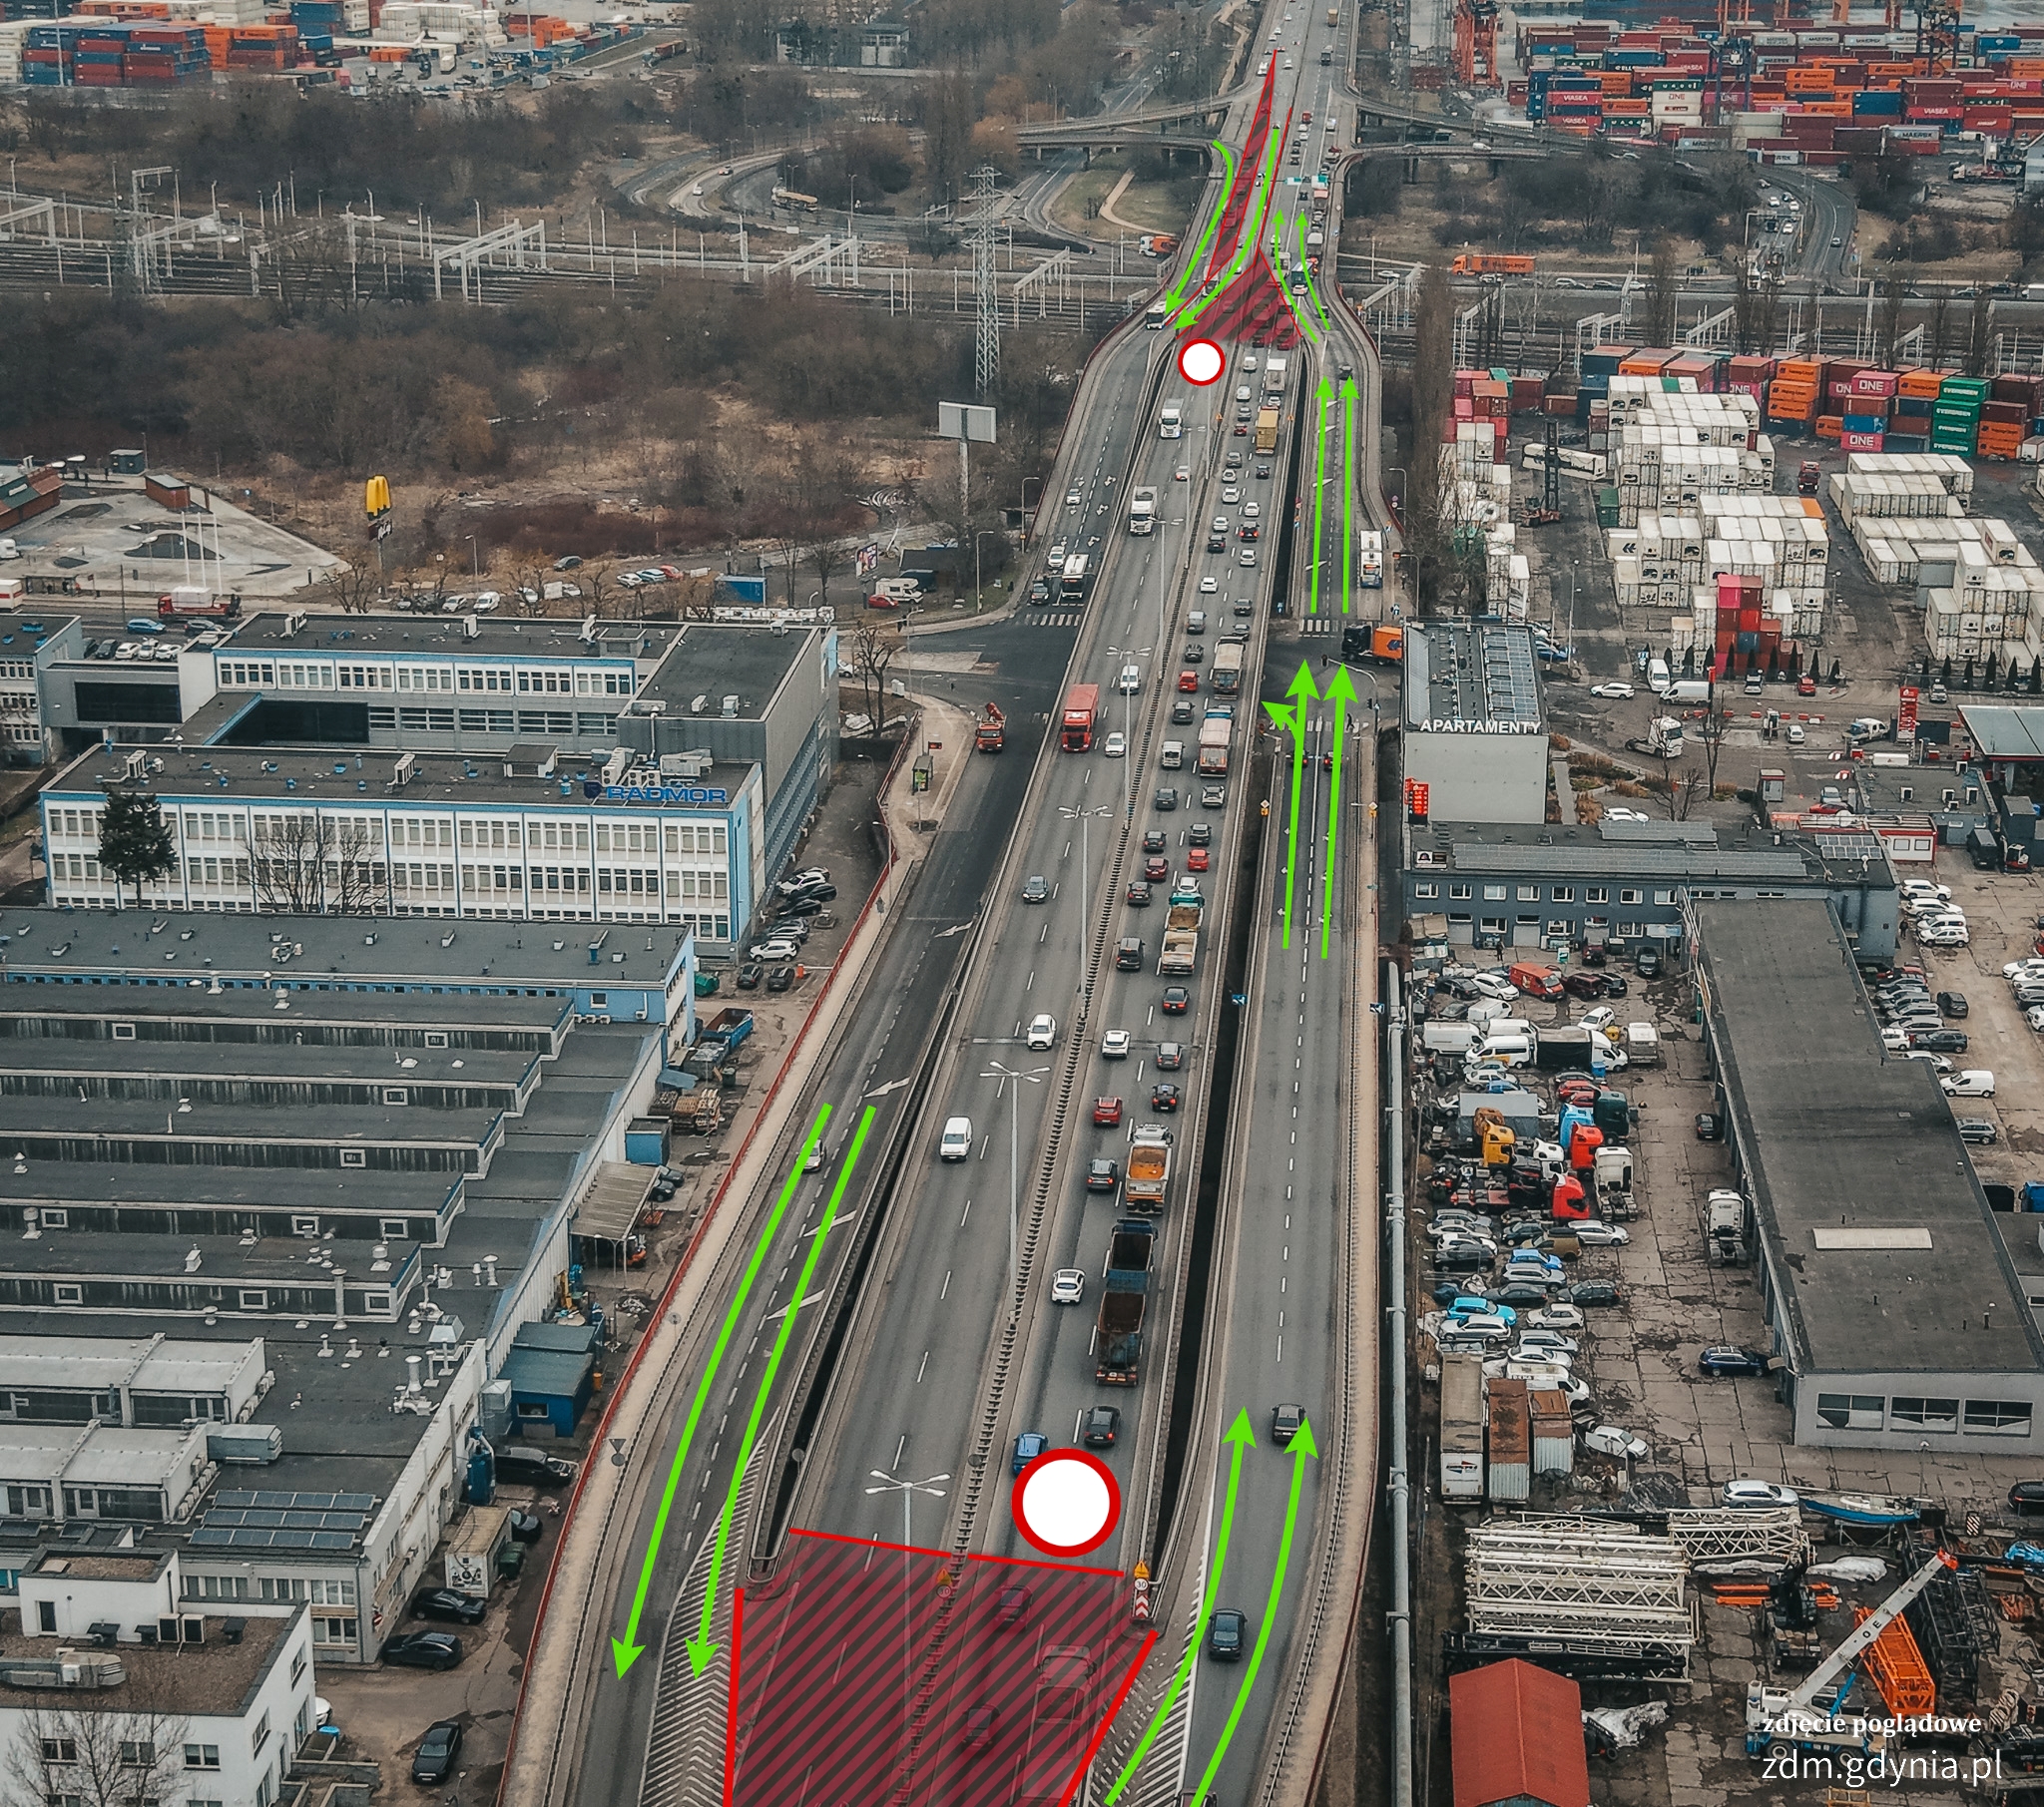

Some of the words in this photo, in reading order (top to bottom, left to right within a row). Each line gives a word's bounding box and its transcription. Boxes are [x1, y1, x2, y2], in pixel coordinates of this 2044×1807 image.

[1858, 380, 1884, 391] ONE
[1943, 386, 1979, 397] EVERGREEN
[1935, 407, 1972, 417] EVERGREEN
[1937, 424, 1967, 433] EVERGREEN
[1848, 434, 1874, 446] ONE
[1933, 442, 1969, 452] EVERGREEN
[1420, 719, 1542, 734] APARTAMENTY
[607, 785, 727, 803] RADMOR
